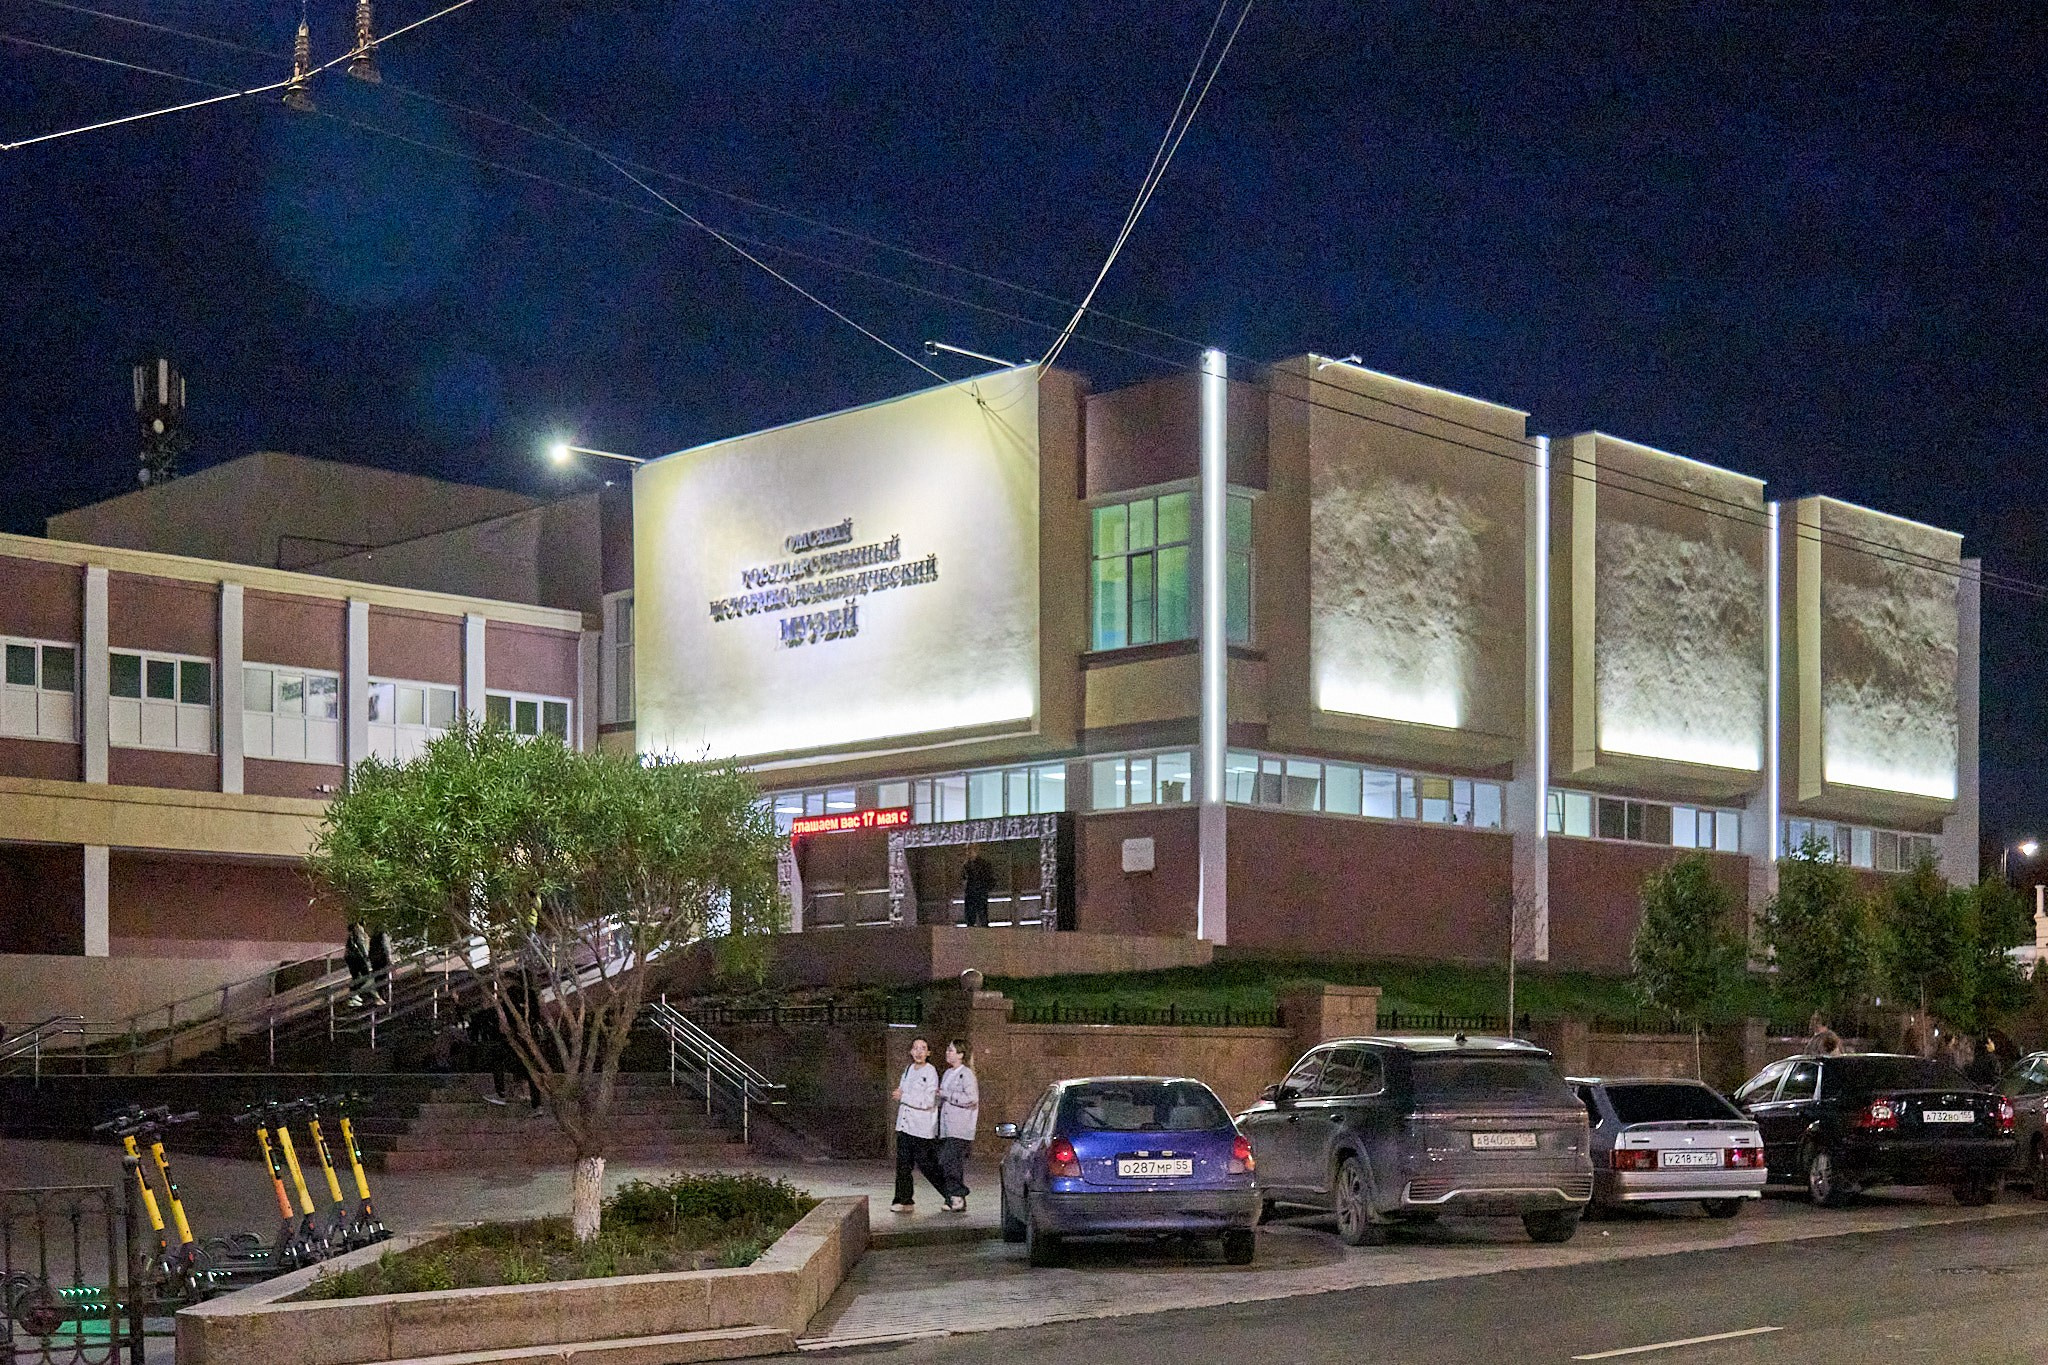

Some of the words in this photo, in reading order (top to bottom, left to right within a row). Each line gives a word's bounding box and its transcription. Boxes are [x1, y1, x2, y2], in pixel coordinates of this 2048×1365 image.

[780, 598, 859, 644] МУЗЕЙ
[841, 816, 860, 829] вас
[862, 812, 875, 827] 17
[877, 812, 899, 826] мая
[900, 811, 908, 823] с
